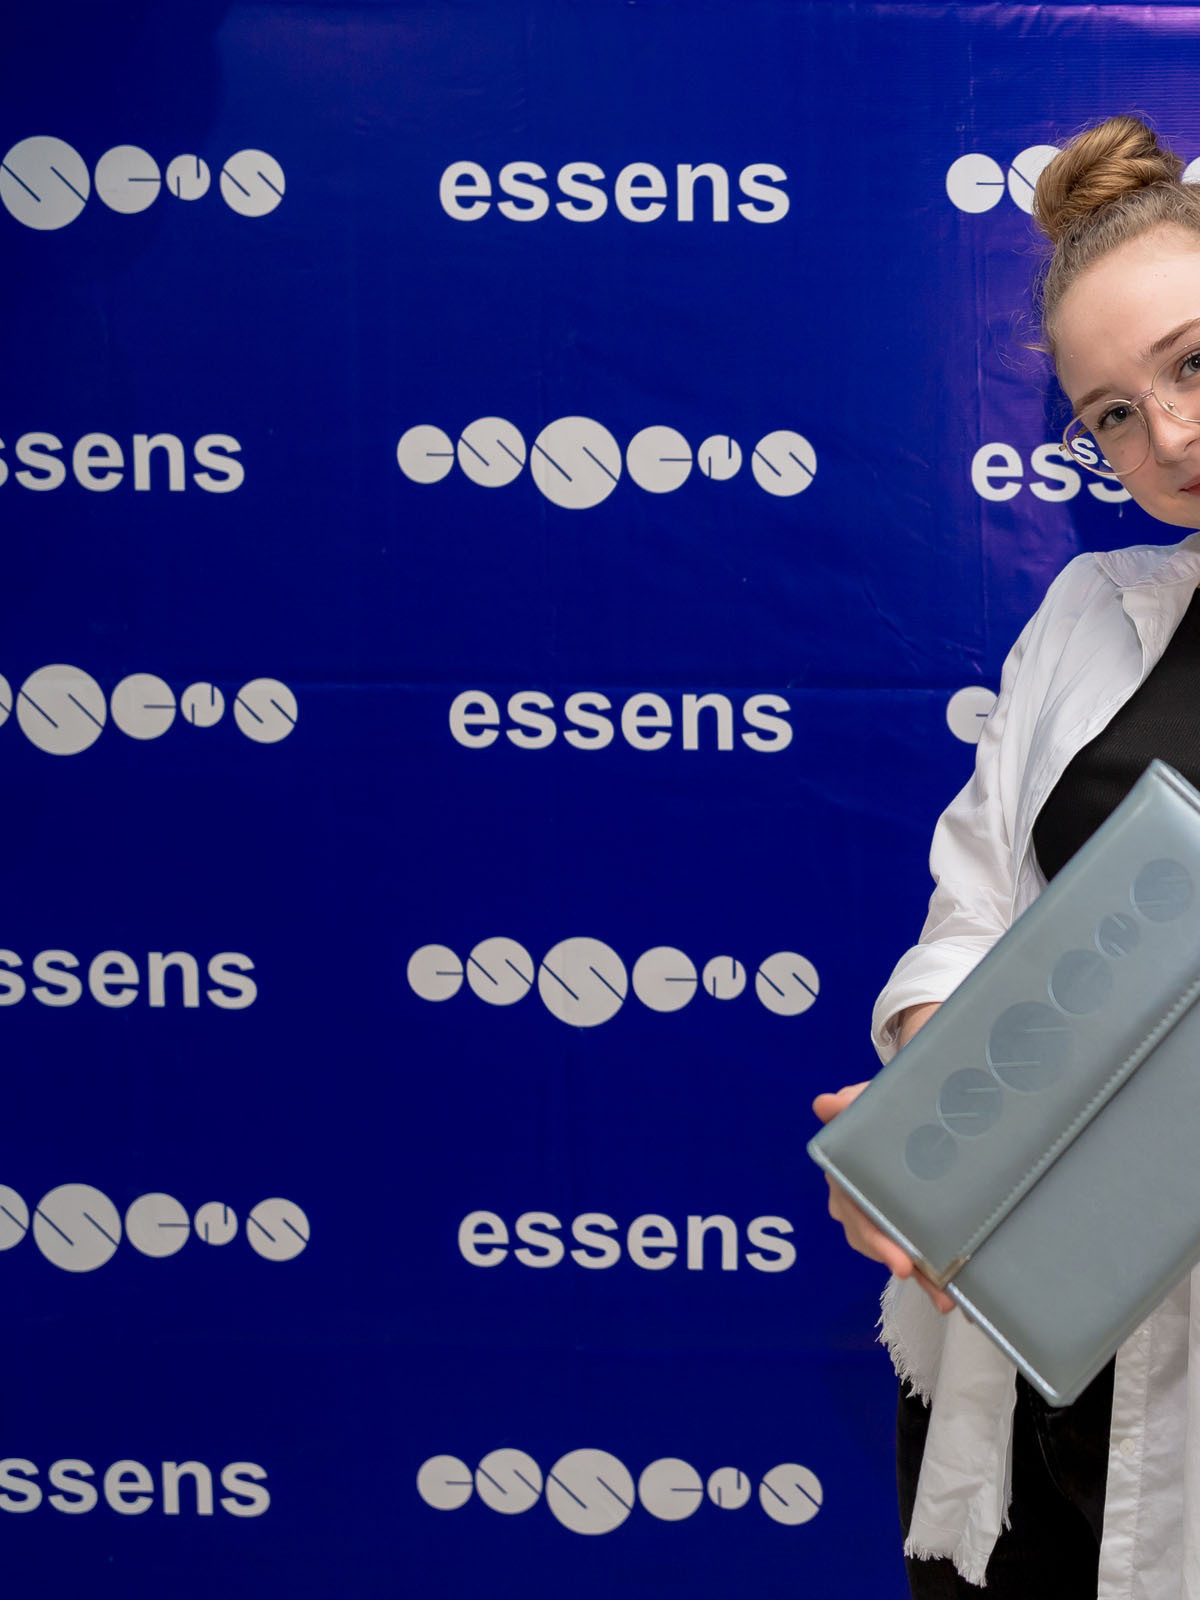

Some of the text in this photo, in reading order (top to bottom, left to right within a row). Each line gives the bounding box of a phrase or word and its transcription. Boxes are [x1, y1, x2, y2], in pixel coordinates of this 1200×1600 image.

[440, 160, 791, 224] essens
[0, 432, 245, 493] sens
[449, 690, 793, 753] essens
[458, 1210, 797, 1273] essens
[0, 1458, 271, 1517] ssens
